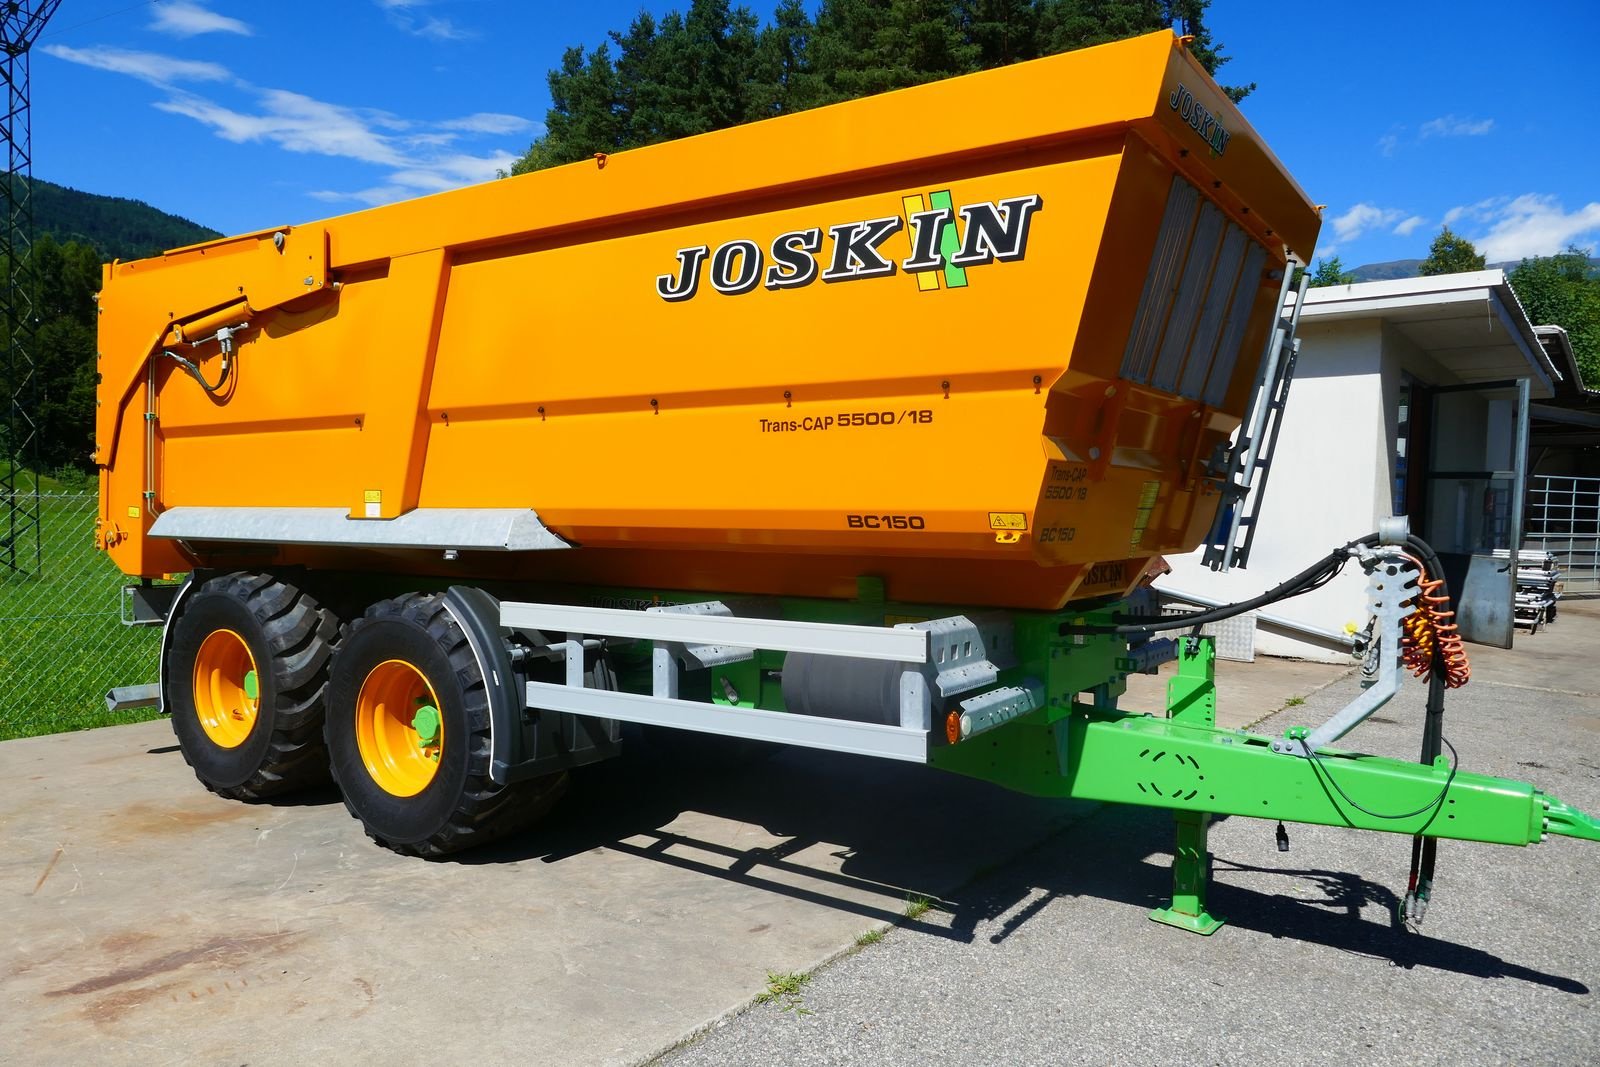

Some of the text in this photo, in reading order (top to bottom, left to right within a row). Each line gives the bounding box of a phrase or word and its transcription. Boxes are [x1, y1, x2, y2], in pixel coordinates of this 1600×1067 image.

[1169, 82, 1231, 157] JOSKIN
[656, 194, 1043, 303] JOSKIN
[759, 409, 933, 433] Trans-CAP 5500/18
[1050, 465, 1088, 482] Trans-CAP
[1045, 486, 1088, 500] 5500/18
[847, 515, 925, 530] BC150
[1040, 527, 1076, 543] BC150
[1083, 562, 1123, 585] OSKIN
